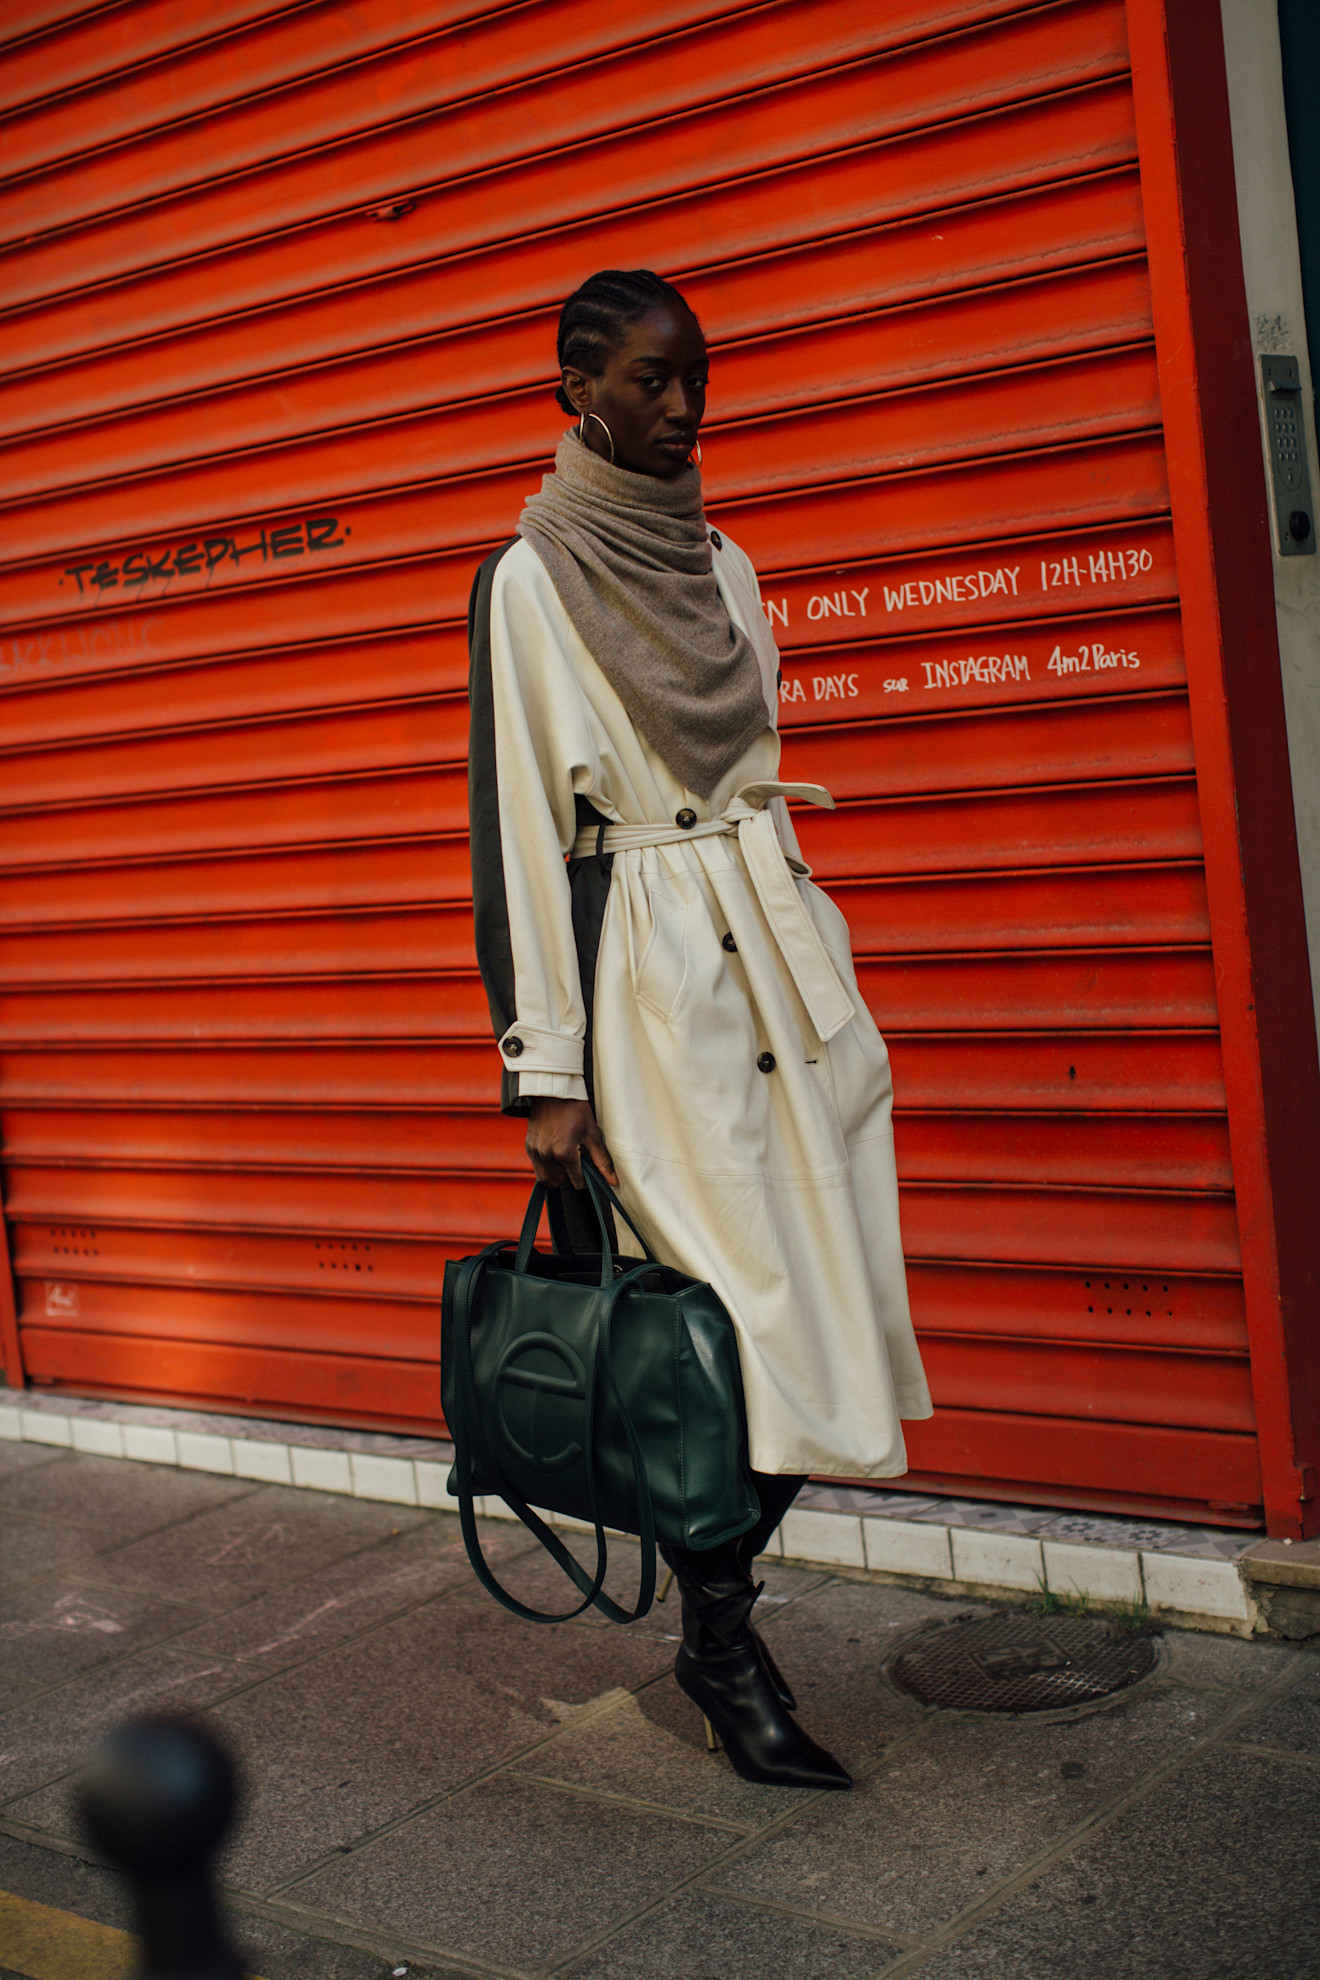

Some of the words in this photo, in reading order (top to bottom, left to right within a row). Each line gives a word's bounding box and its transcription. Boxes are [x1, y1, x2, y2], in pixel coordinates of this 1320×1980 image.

[807, 587, 869, 620] ONLY
[883, 566, 1021, 612] WEDNESDAY
[1041, 548, 1153, 591] 12H-14H30
[812, 674, 859, 701] DAYS
[920, 654, 1031, 689] INSTAGRAM
